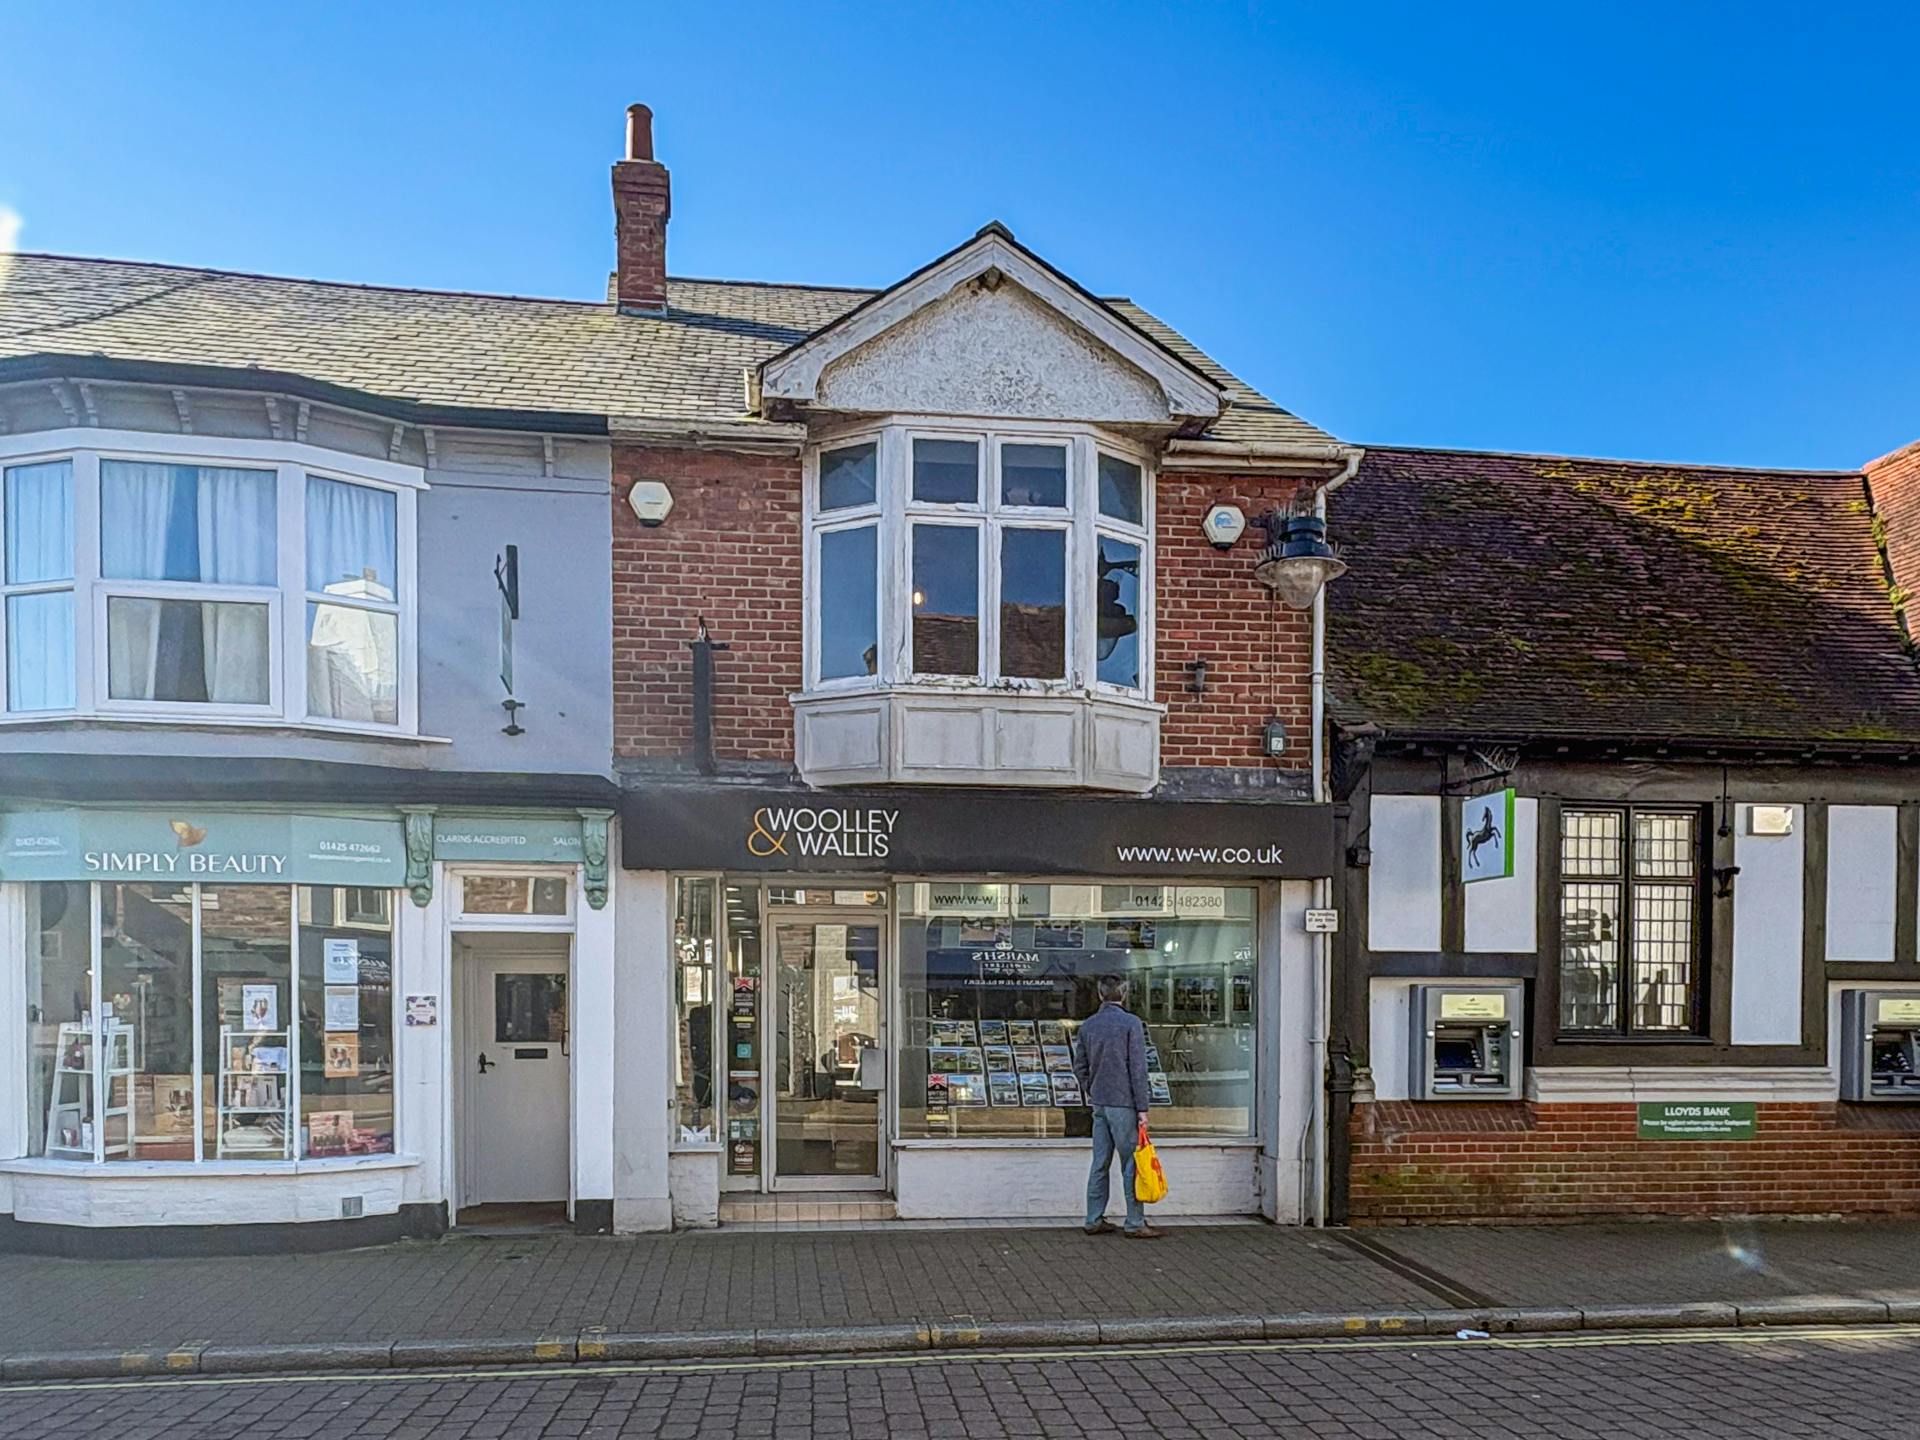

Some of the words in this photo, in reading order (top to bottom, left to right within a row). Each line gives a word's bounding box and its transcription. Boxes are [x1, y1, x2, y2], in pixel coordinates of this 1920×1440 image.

[766, 807, 899, 834] WOOLLEY
[746, 807, 789, 856] &
[796, 832, 890, 858] WALLIS
[319, 841, 348, 852] 01425
[436, 834, 472, 844] CLARINS
[473, 835, 526, 845] ACCREDITED
[552, 836, 581, 846] SALON
[1116, 843, 1283, 864] www.w-w.co.uk
[84, 852, 183, 873] SIMPLY
[189, 853, 287, 874] BEAUTY
[933, 892, 1030, 906] www.w-w.co.uk
[1134, 895, 1174, 908] 01425
[1176, 895, 1223, 908] 482380
[1664, 1107, 1702, 1117] LLOYDS
[1703, 1107, 1731, 1117] BANK
